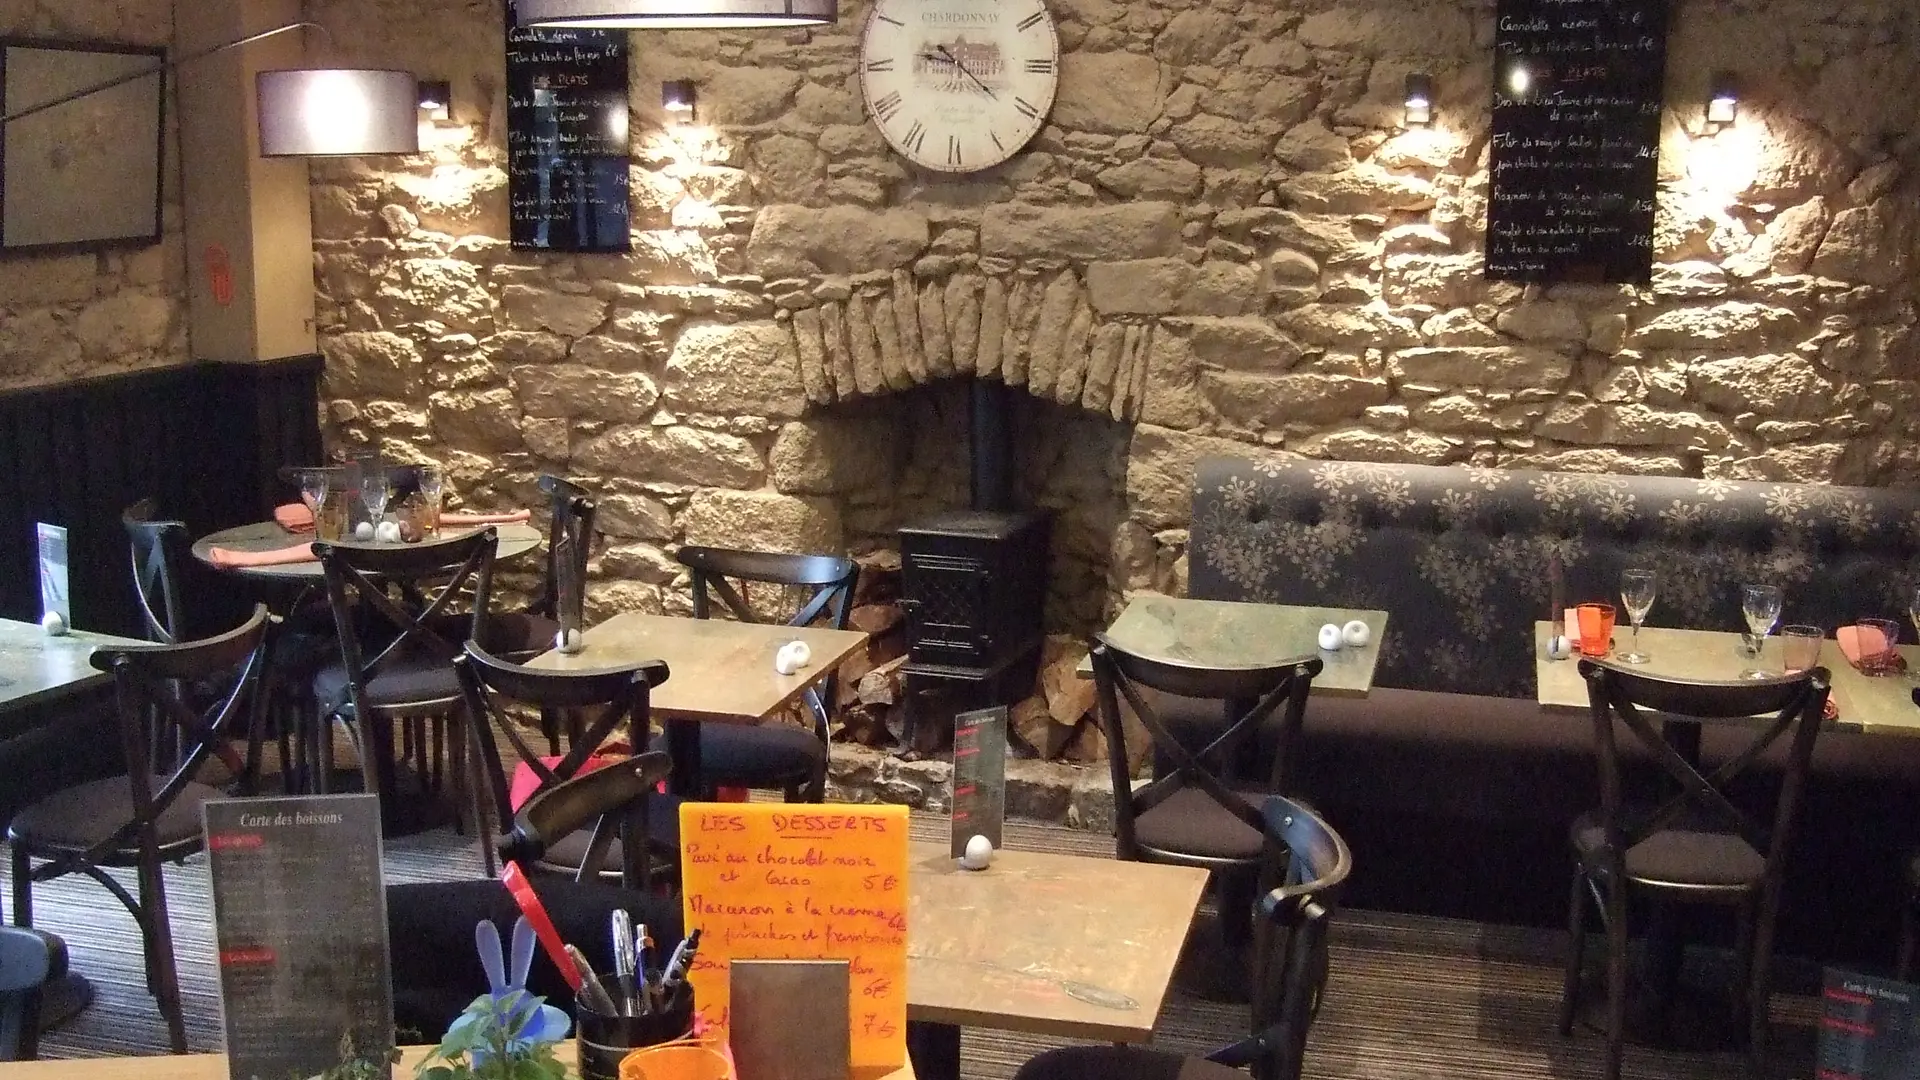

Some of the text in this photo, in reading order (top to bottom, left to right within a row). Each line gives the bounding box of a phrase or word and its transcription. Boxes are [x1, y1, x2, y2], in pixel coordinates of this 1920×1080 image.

[921, 12, 1000, 23] CHARDONNAY
[559, 74, 588, 86] PLATS
[240, 811, 343, 828] Carte des boissons
[700, 814, 886, 833] LES DESSERTS
[757, 844, 828, 867] chocolat
[720, 869, 741, 882] et
[689, 894, 774, 915] Macaron
[805, 897, 822, 916] la
